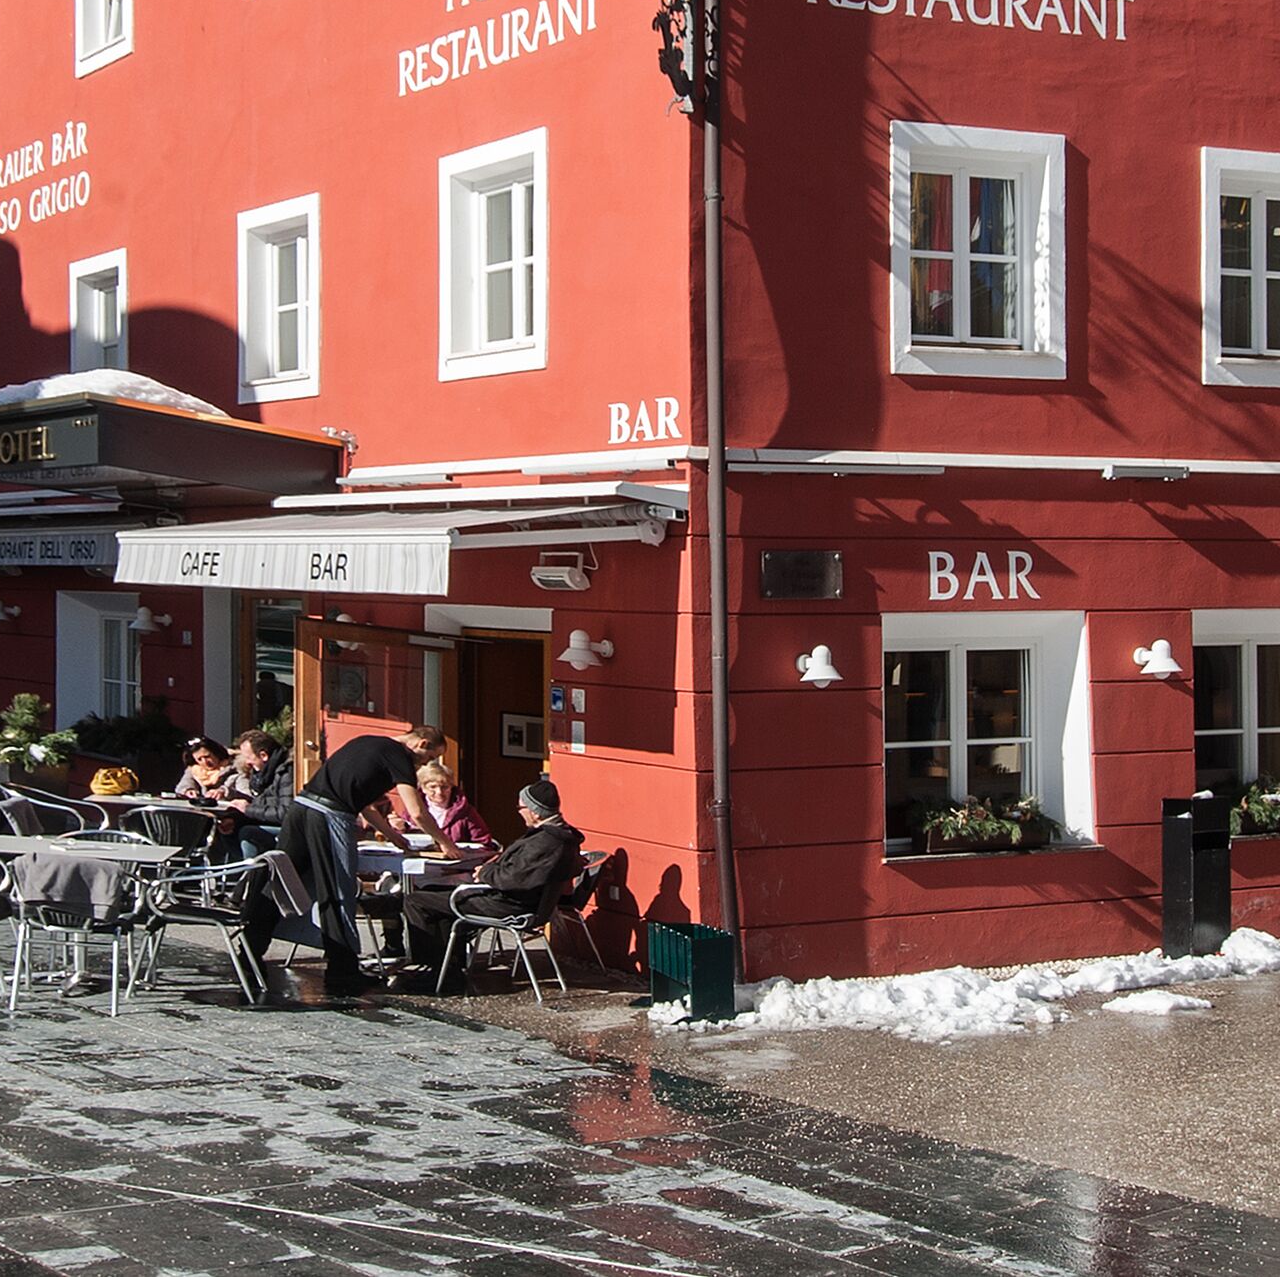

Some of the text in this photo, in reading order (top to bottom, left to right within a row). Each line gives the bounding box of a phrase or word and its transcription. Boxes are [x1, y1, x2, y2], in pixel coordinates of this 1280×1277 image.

[51, 120, 89, 167] BÄR
[28, 170, 91, 223] GRIGIO
[607, 396, 683, 445] BAR
[40, 540, 65, 559] DELL'
[70, 539, 97, 559] ORSO
[180, 551, 348, 581] CAFE BAR
[927, 550, 1041, 600] BAR
